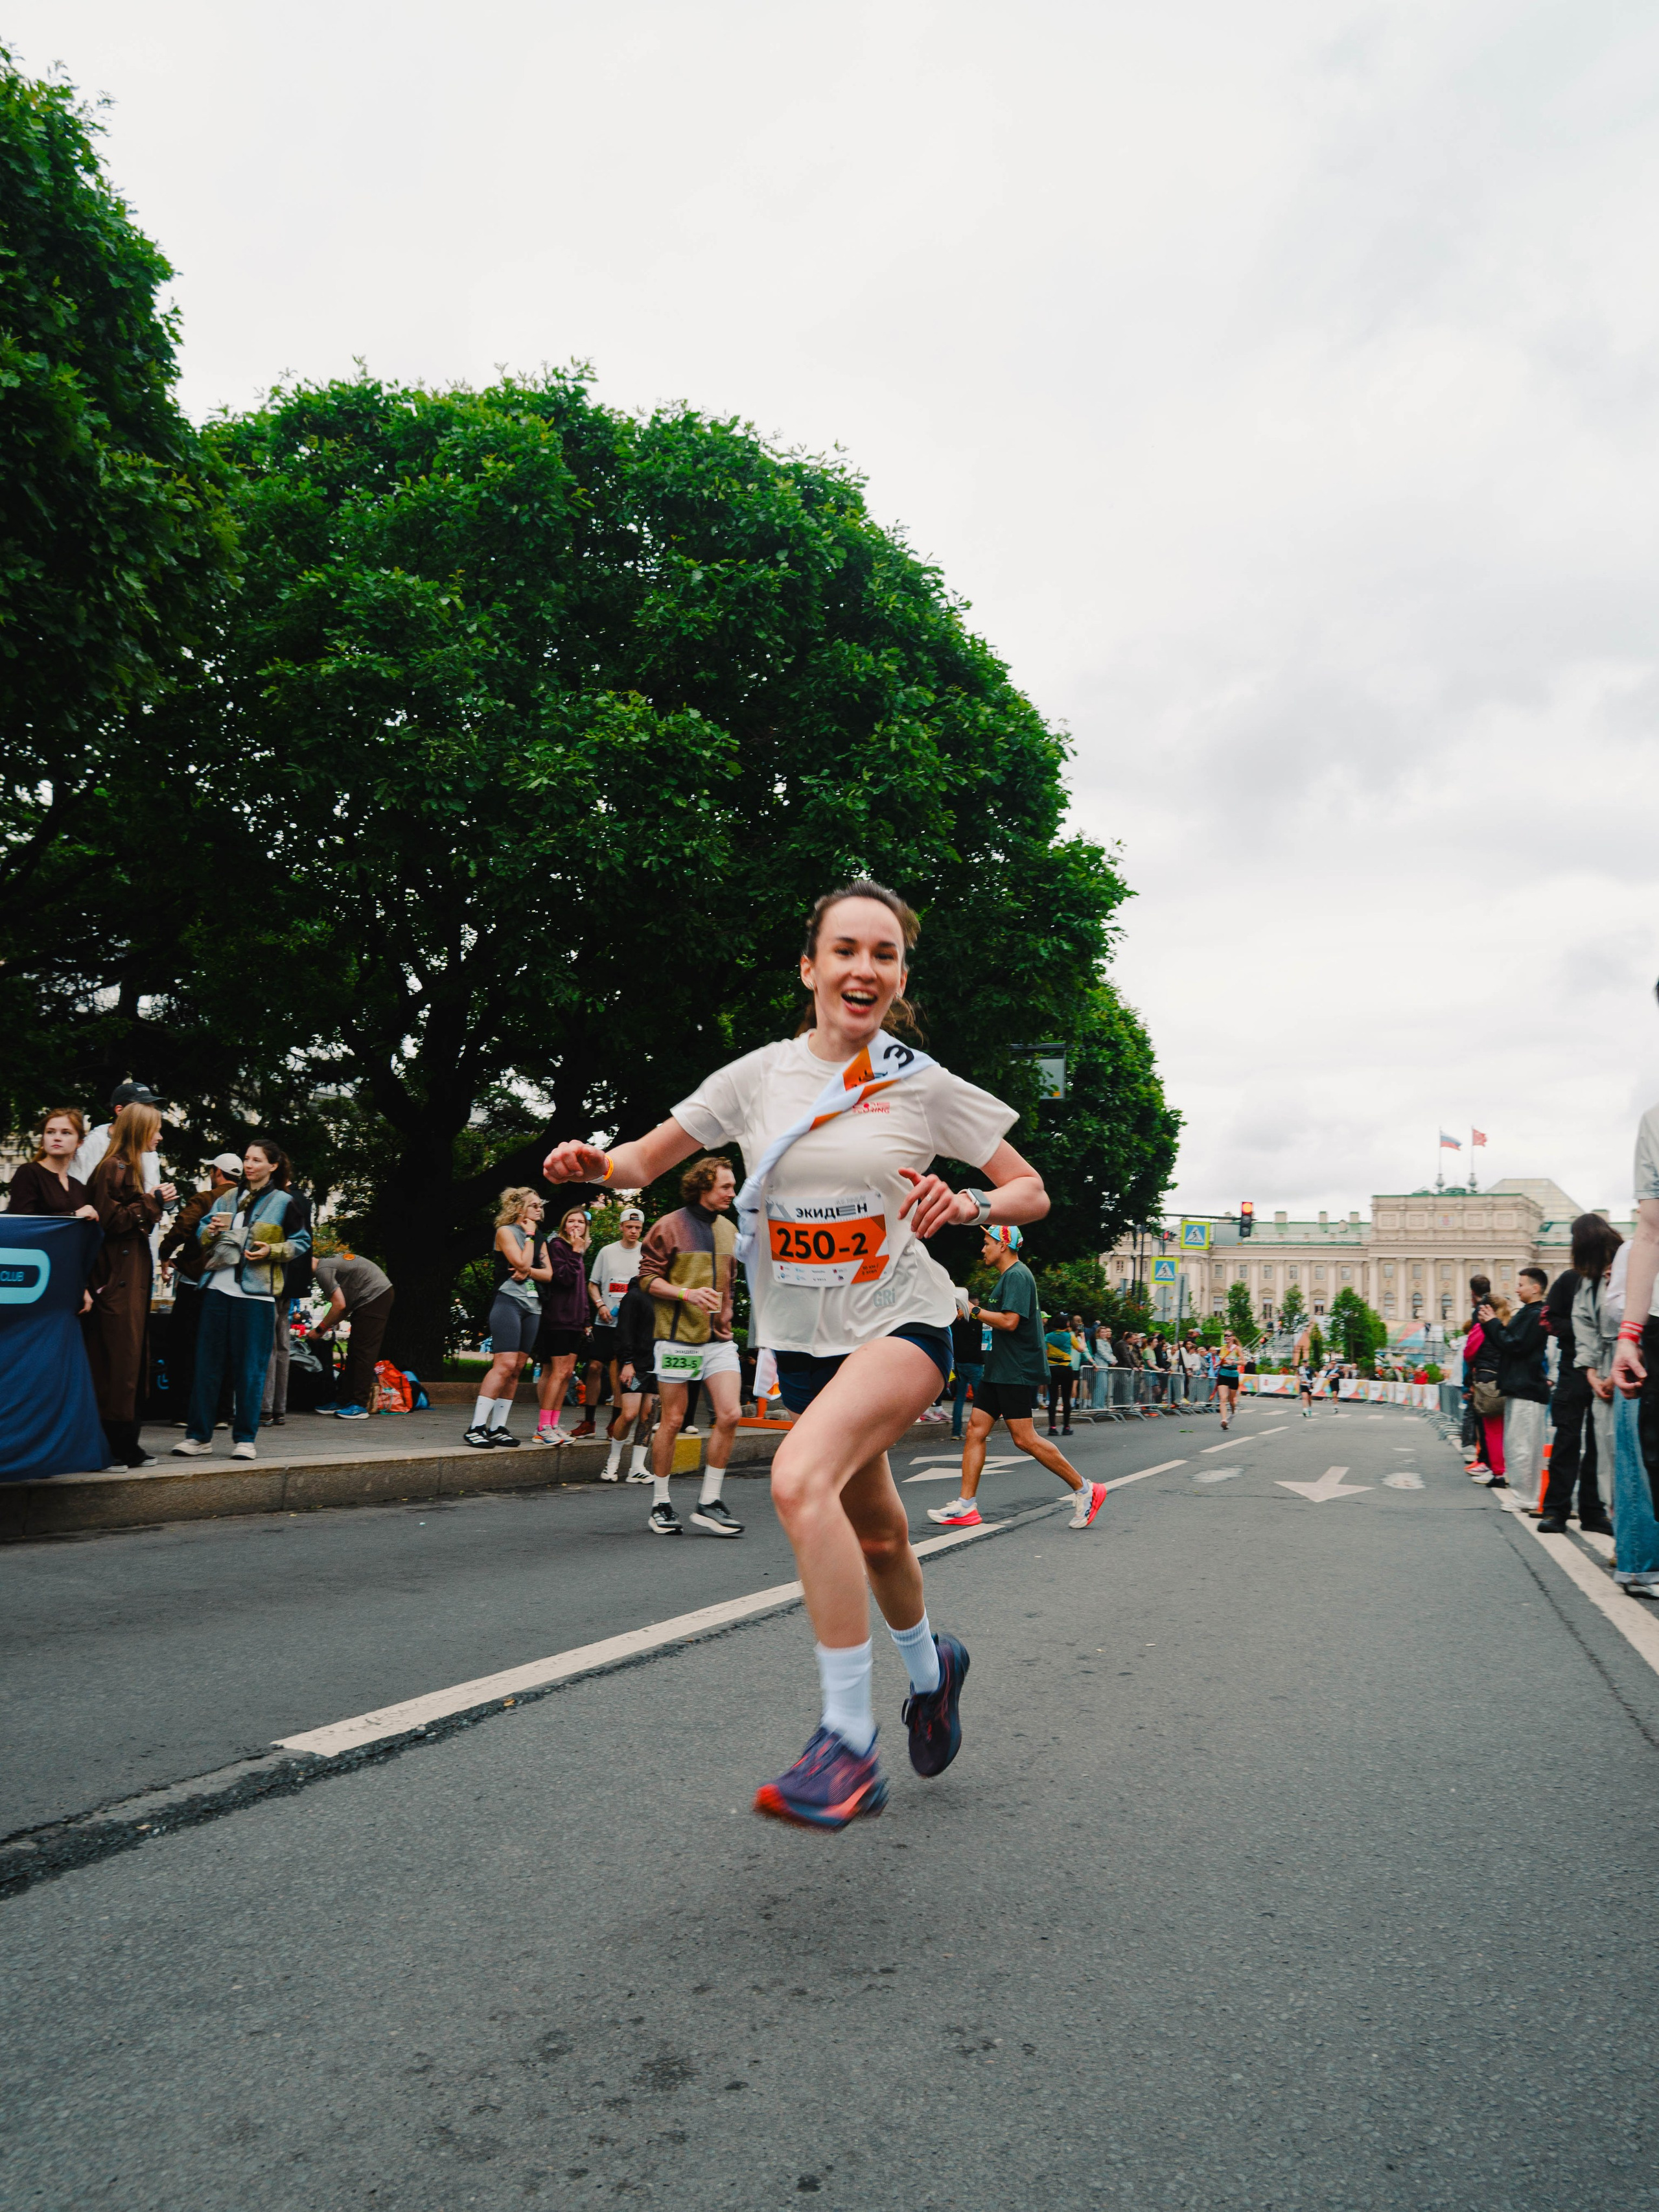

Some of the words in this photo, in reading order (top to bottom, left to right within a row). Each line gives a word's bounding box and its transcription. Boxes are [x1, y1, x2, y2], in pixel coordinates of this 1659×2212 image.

[795, 1203, 868, 1220] ЭКИДЕН
[776, 1228, 868, 1259] 250-2
[664, 1356, 698, 1369] 323-5
